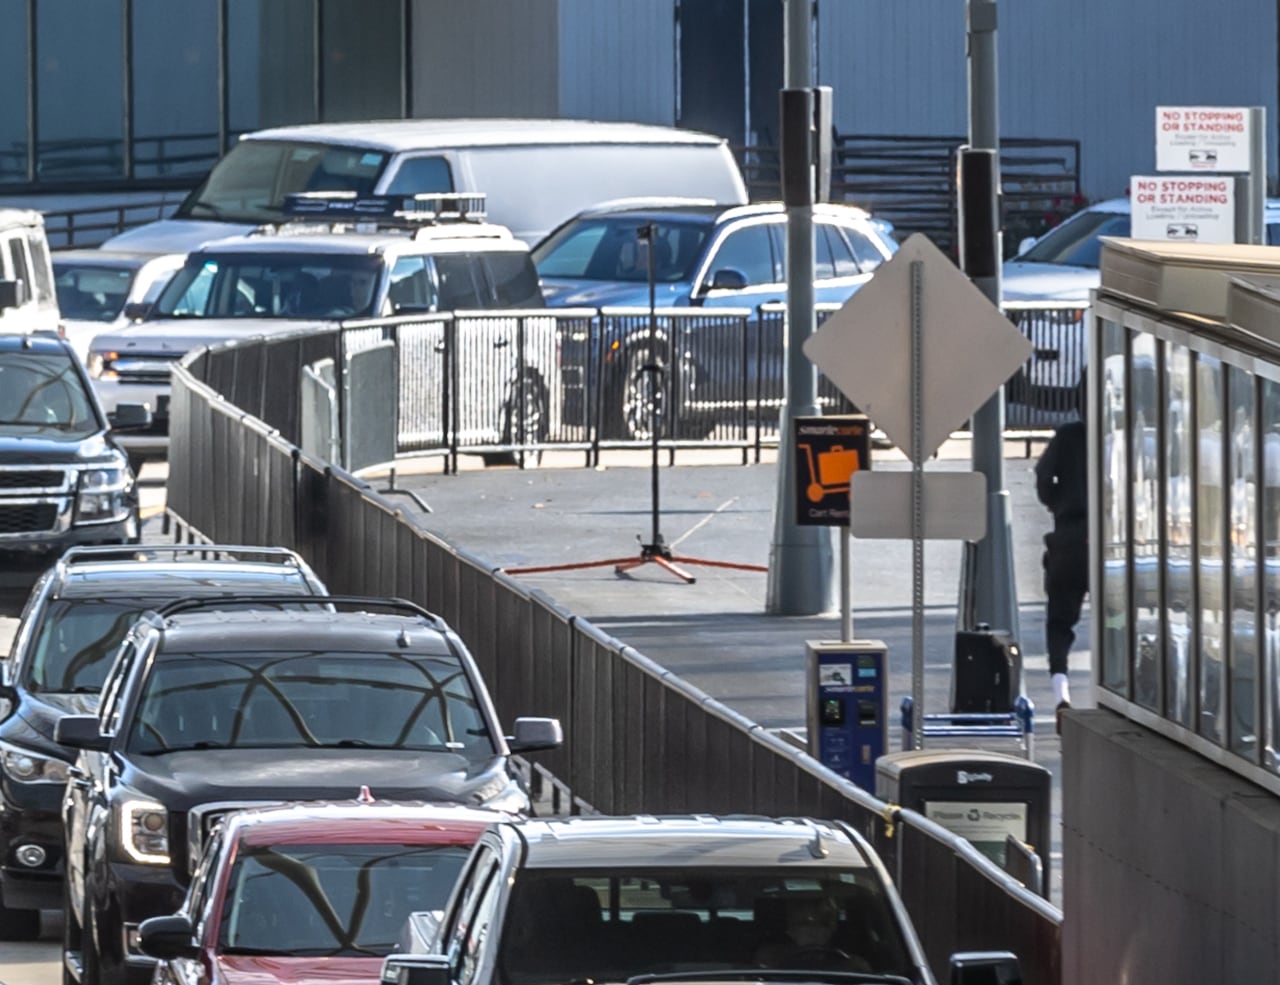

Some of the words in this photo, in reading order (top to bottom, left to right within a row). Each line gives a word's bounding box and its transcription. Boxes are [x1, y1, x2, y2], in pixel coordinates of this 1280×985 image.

[1162, 112, 1181, 121] NO
[1184, 112, 1244, 122] STOPPING
[1162, 122, 1180, 132] OR
[1183, 122, 1245, 133] STANDING
[1137, 181, 1157, 191] NO
[1162, 181, 1227, 192] STOPPING
[1137, 193, 1156, 204] OR
[1159, 193, 1228, 205] STANDING
